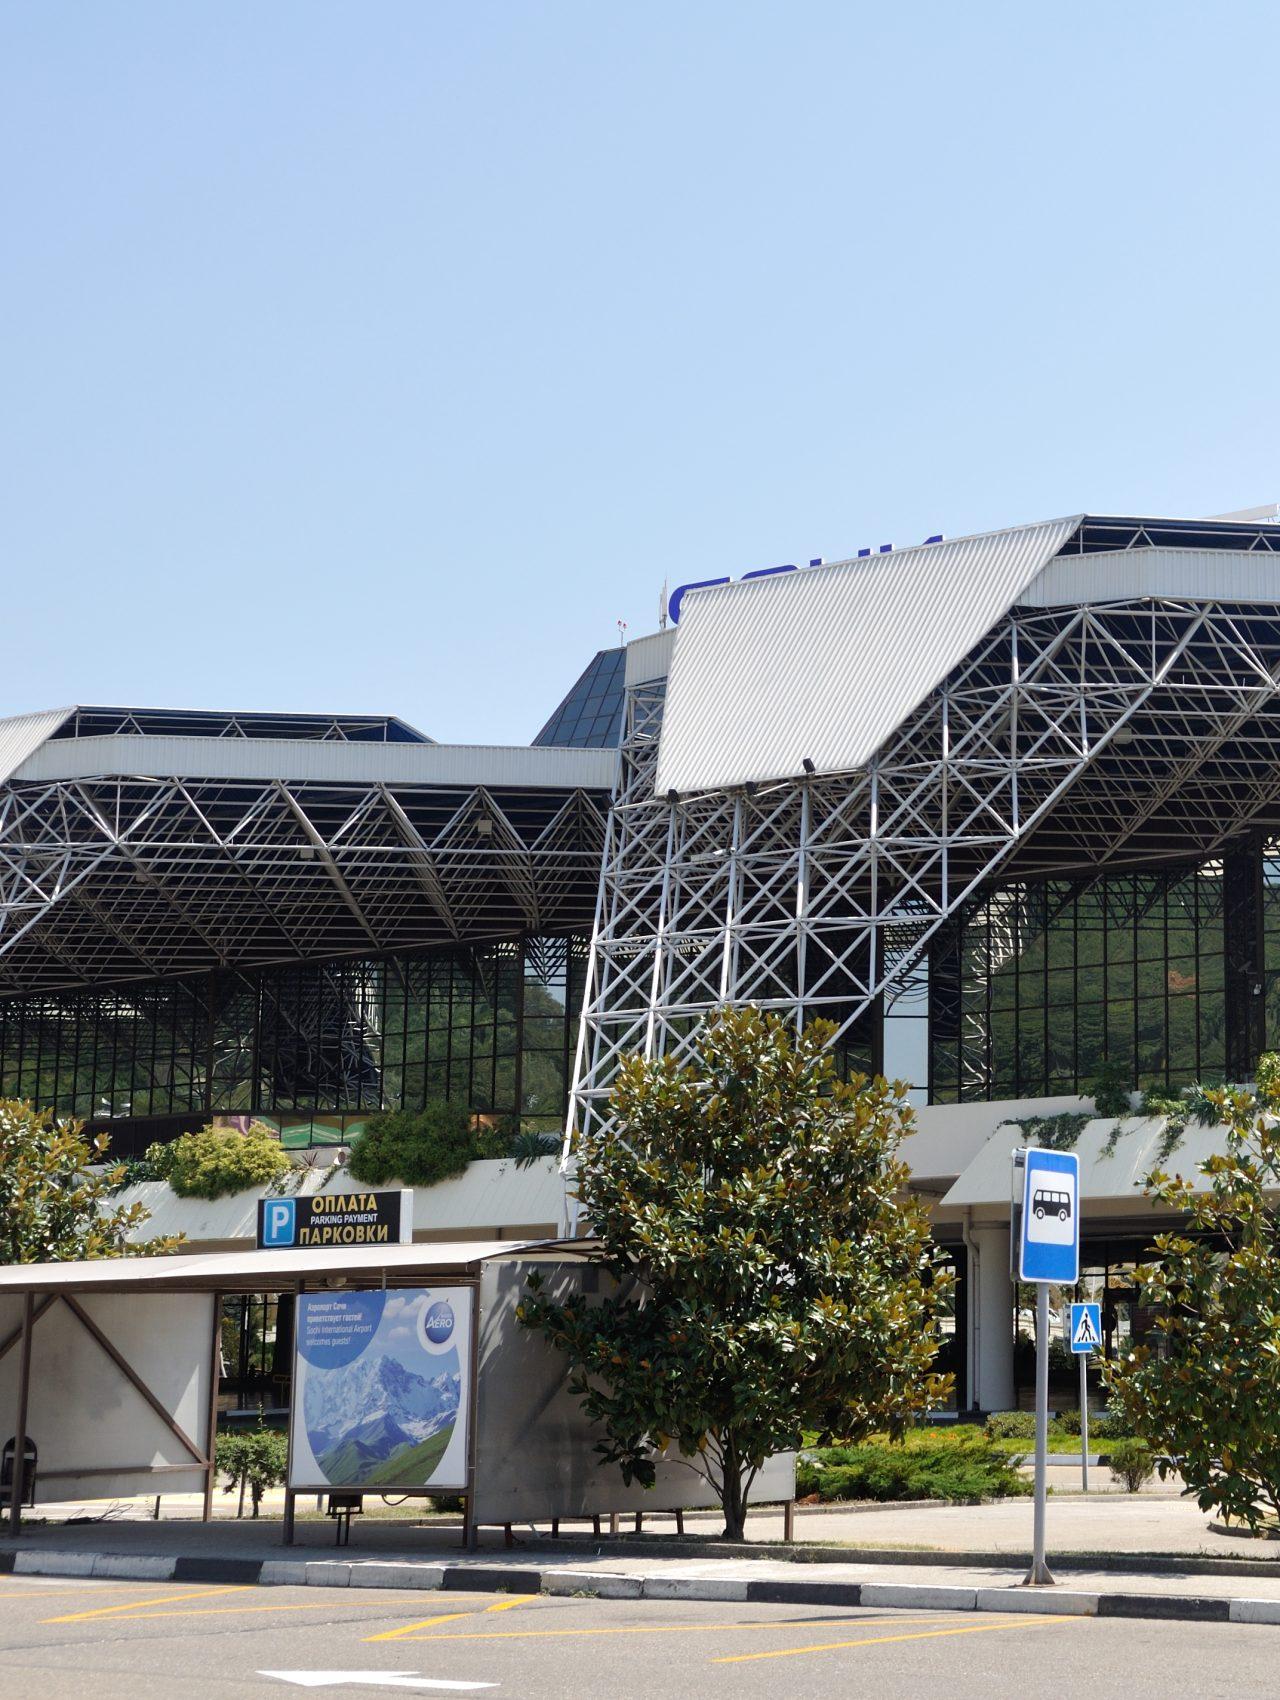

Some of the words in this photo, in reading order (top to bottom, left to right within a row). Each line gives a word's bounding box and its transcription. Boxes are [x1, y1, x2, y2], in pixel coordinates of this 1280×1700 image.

[311, 1194, 378, 1214] ОПЛАТА
[272, 1206, 290, 1239] P
[310, 1214, 343, 1225] PARKING
[344, 1213, 378, 1223] PAYMENT
[299, 1225, 388, 1245] ПАРКОВКИ
[306, 1326, 320, 1335] Sochi
[321, 1325, 353, 1334] International
[353, 1324, 372, 1334] Airport
